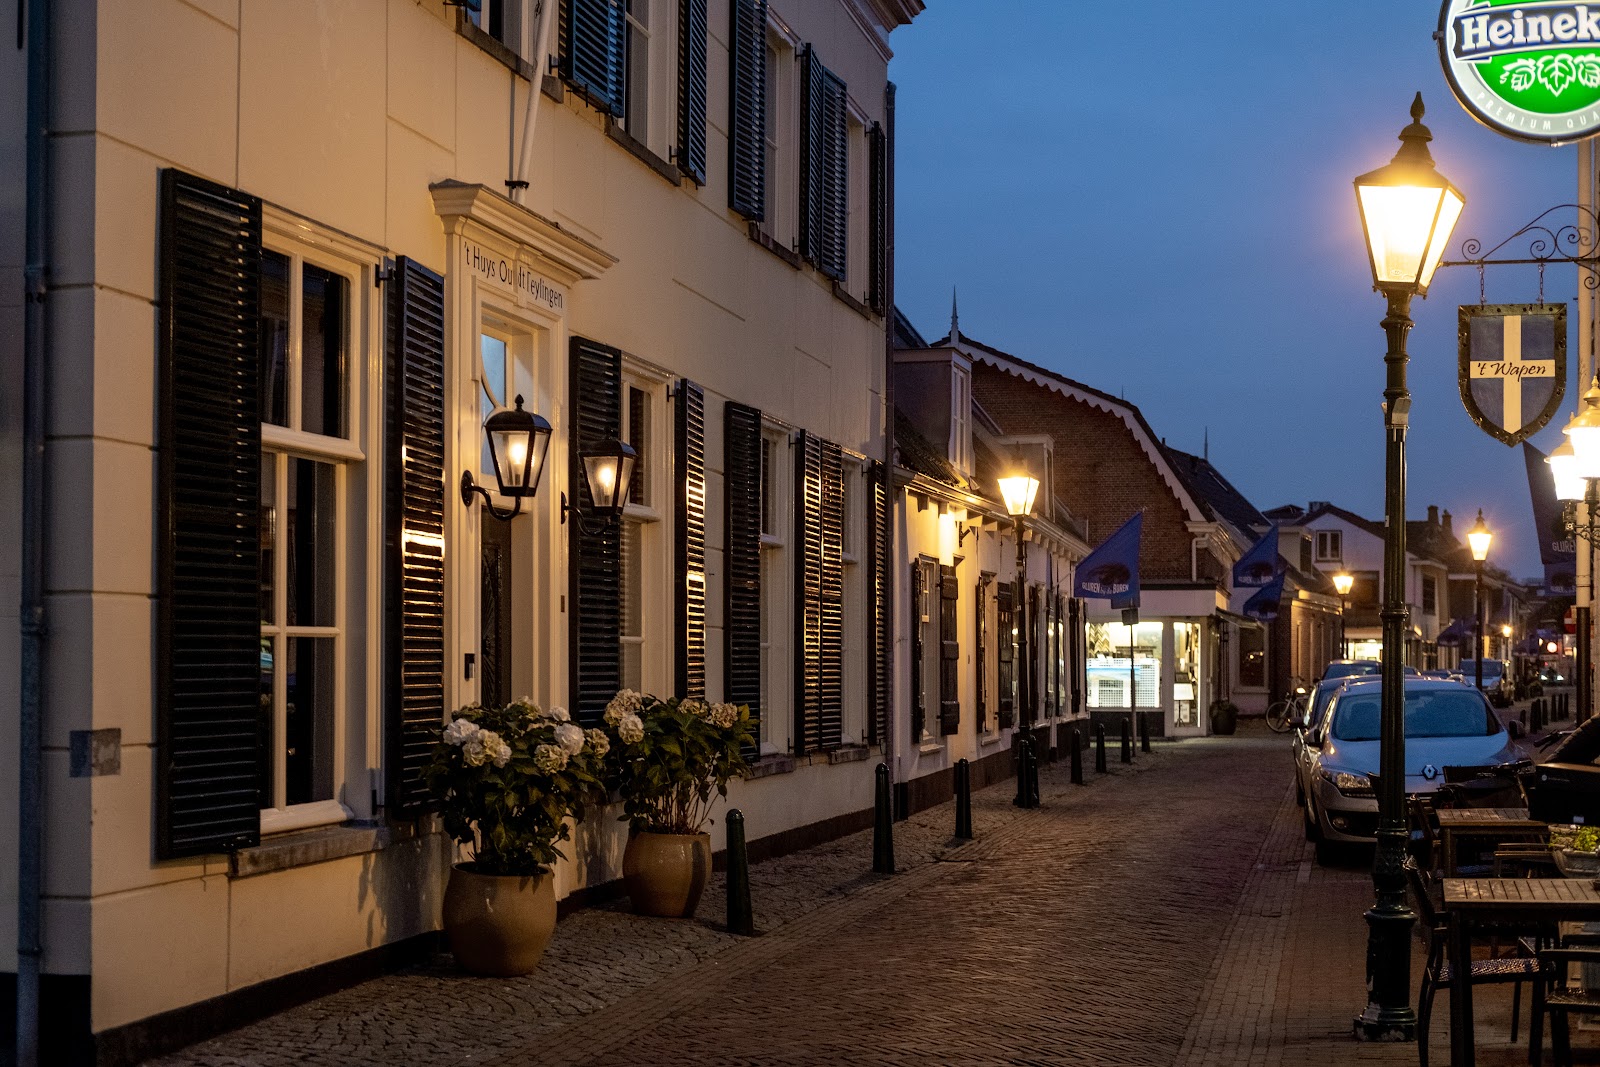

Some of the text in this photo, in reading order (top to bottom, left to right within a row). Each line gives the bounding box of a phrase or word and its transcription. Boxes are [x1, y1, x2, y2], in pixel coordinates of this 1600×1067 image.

[1477, 92, 1551, 130] PREMIUM
[473, 246, 495, 279] Huys
[526, 271, 563, 309] Teylingen
[1477, 362, 1547, 382] 't Wapen
[1082, 582, 1100, 593] GLUREN
[1113, 584, 1129, 594] BUREN
